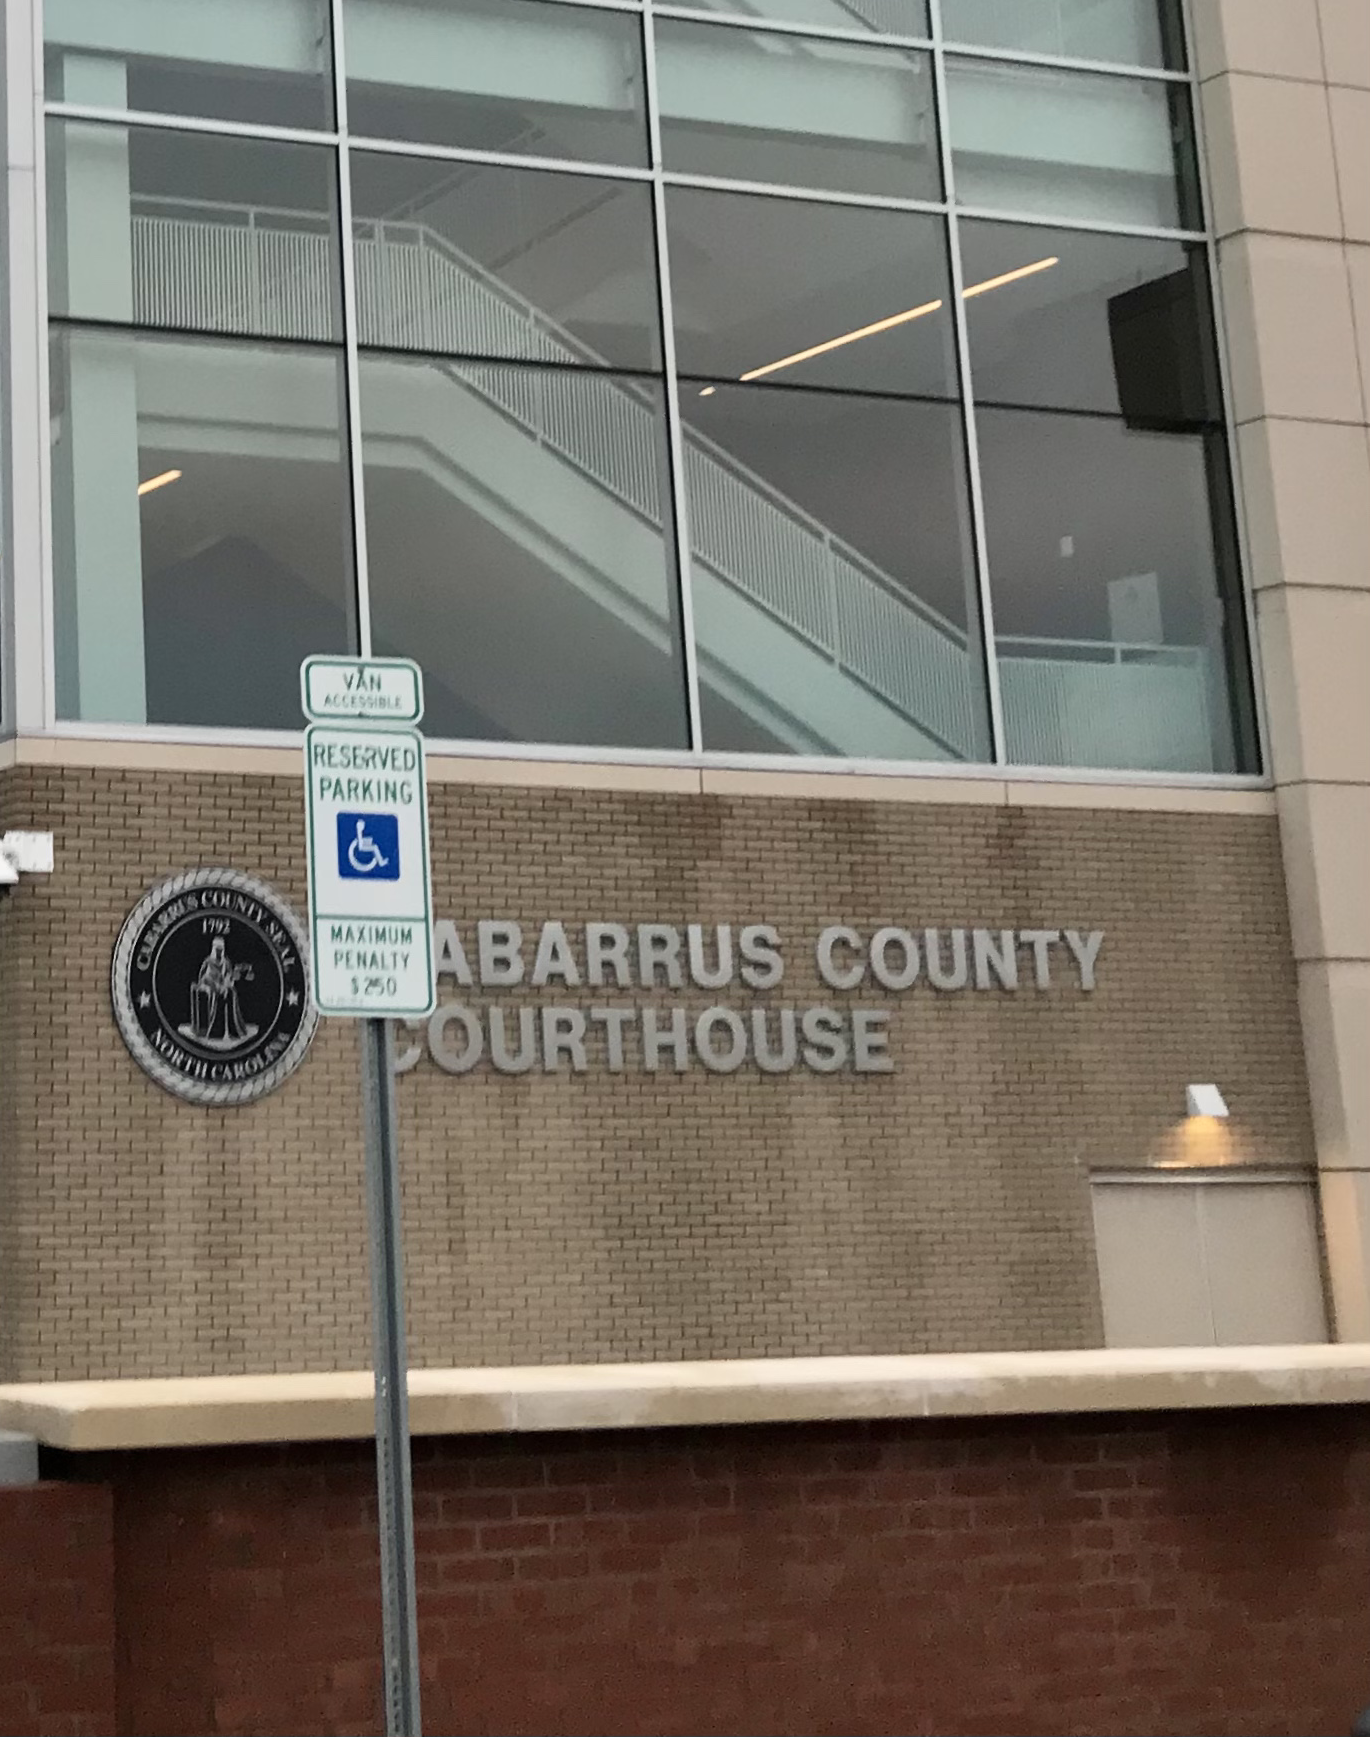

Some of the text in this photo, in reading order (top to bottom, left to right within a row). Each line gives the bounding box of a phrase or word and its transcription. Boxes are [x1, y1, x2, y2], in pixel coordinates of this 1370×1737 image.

[343, 672, 382, 691] VAN
[323, 693, 402, 709] ACCESSIBLE
[312, 742, 416, 771] RESERVED
[319, 776, 413, 804] PARKING
[201, 889, 269, 924] COUNTY
[330, 925, 413, 946] MAXIMUM
[333, 949, 411, 970] PENALTY
[434, 920, 1105, 994] ABARRUS COUNTY
[150, 1028, 208, 1078] NORTH
